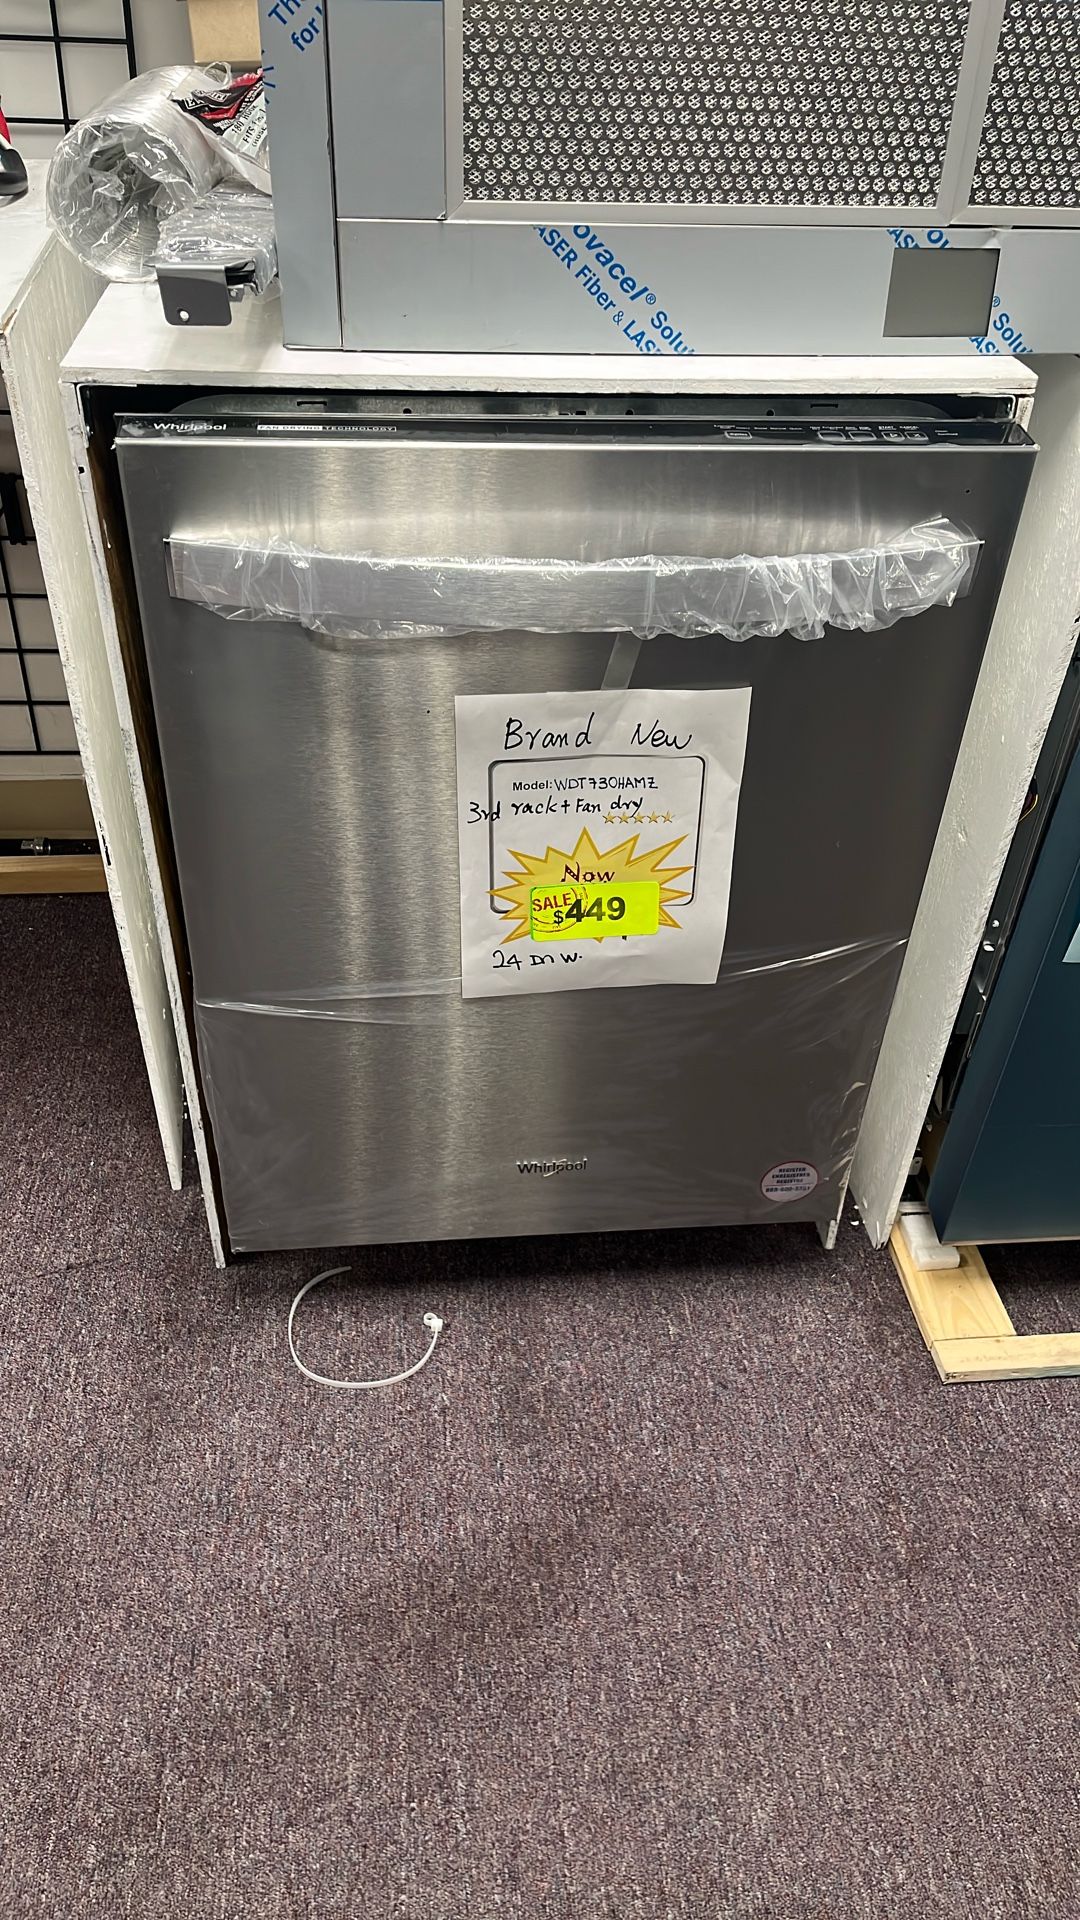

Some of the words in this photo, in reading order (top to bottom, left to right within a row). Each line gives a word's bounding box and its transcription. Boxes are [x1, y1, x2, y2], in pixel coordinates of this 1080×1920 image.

[291, 17, 320, 52] for
[887, 229, 920, 248] AS
[575, 264, 616, 311] Fiber
[612, 310, 624, 326] &
[623, 320, 662, 353] LAS
[153, 423, 227, 433] Whirlpool
[504, 712, 593, 750] Brand
[631, 719, 693, 749] New
[512, 779, 553, 791] Model:
[467, 801, 501, 824] 3rd
[610, 795, 643, 818] dry
[560, 861, 615, 882] Now
[532, 892, 573, 912] SALE
[553, 896, 626, 925] $449
[492, 950, 522, 970] 24
[516, 1158, 588, 1176] Whirlpool
